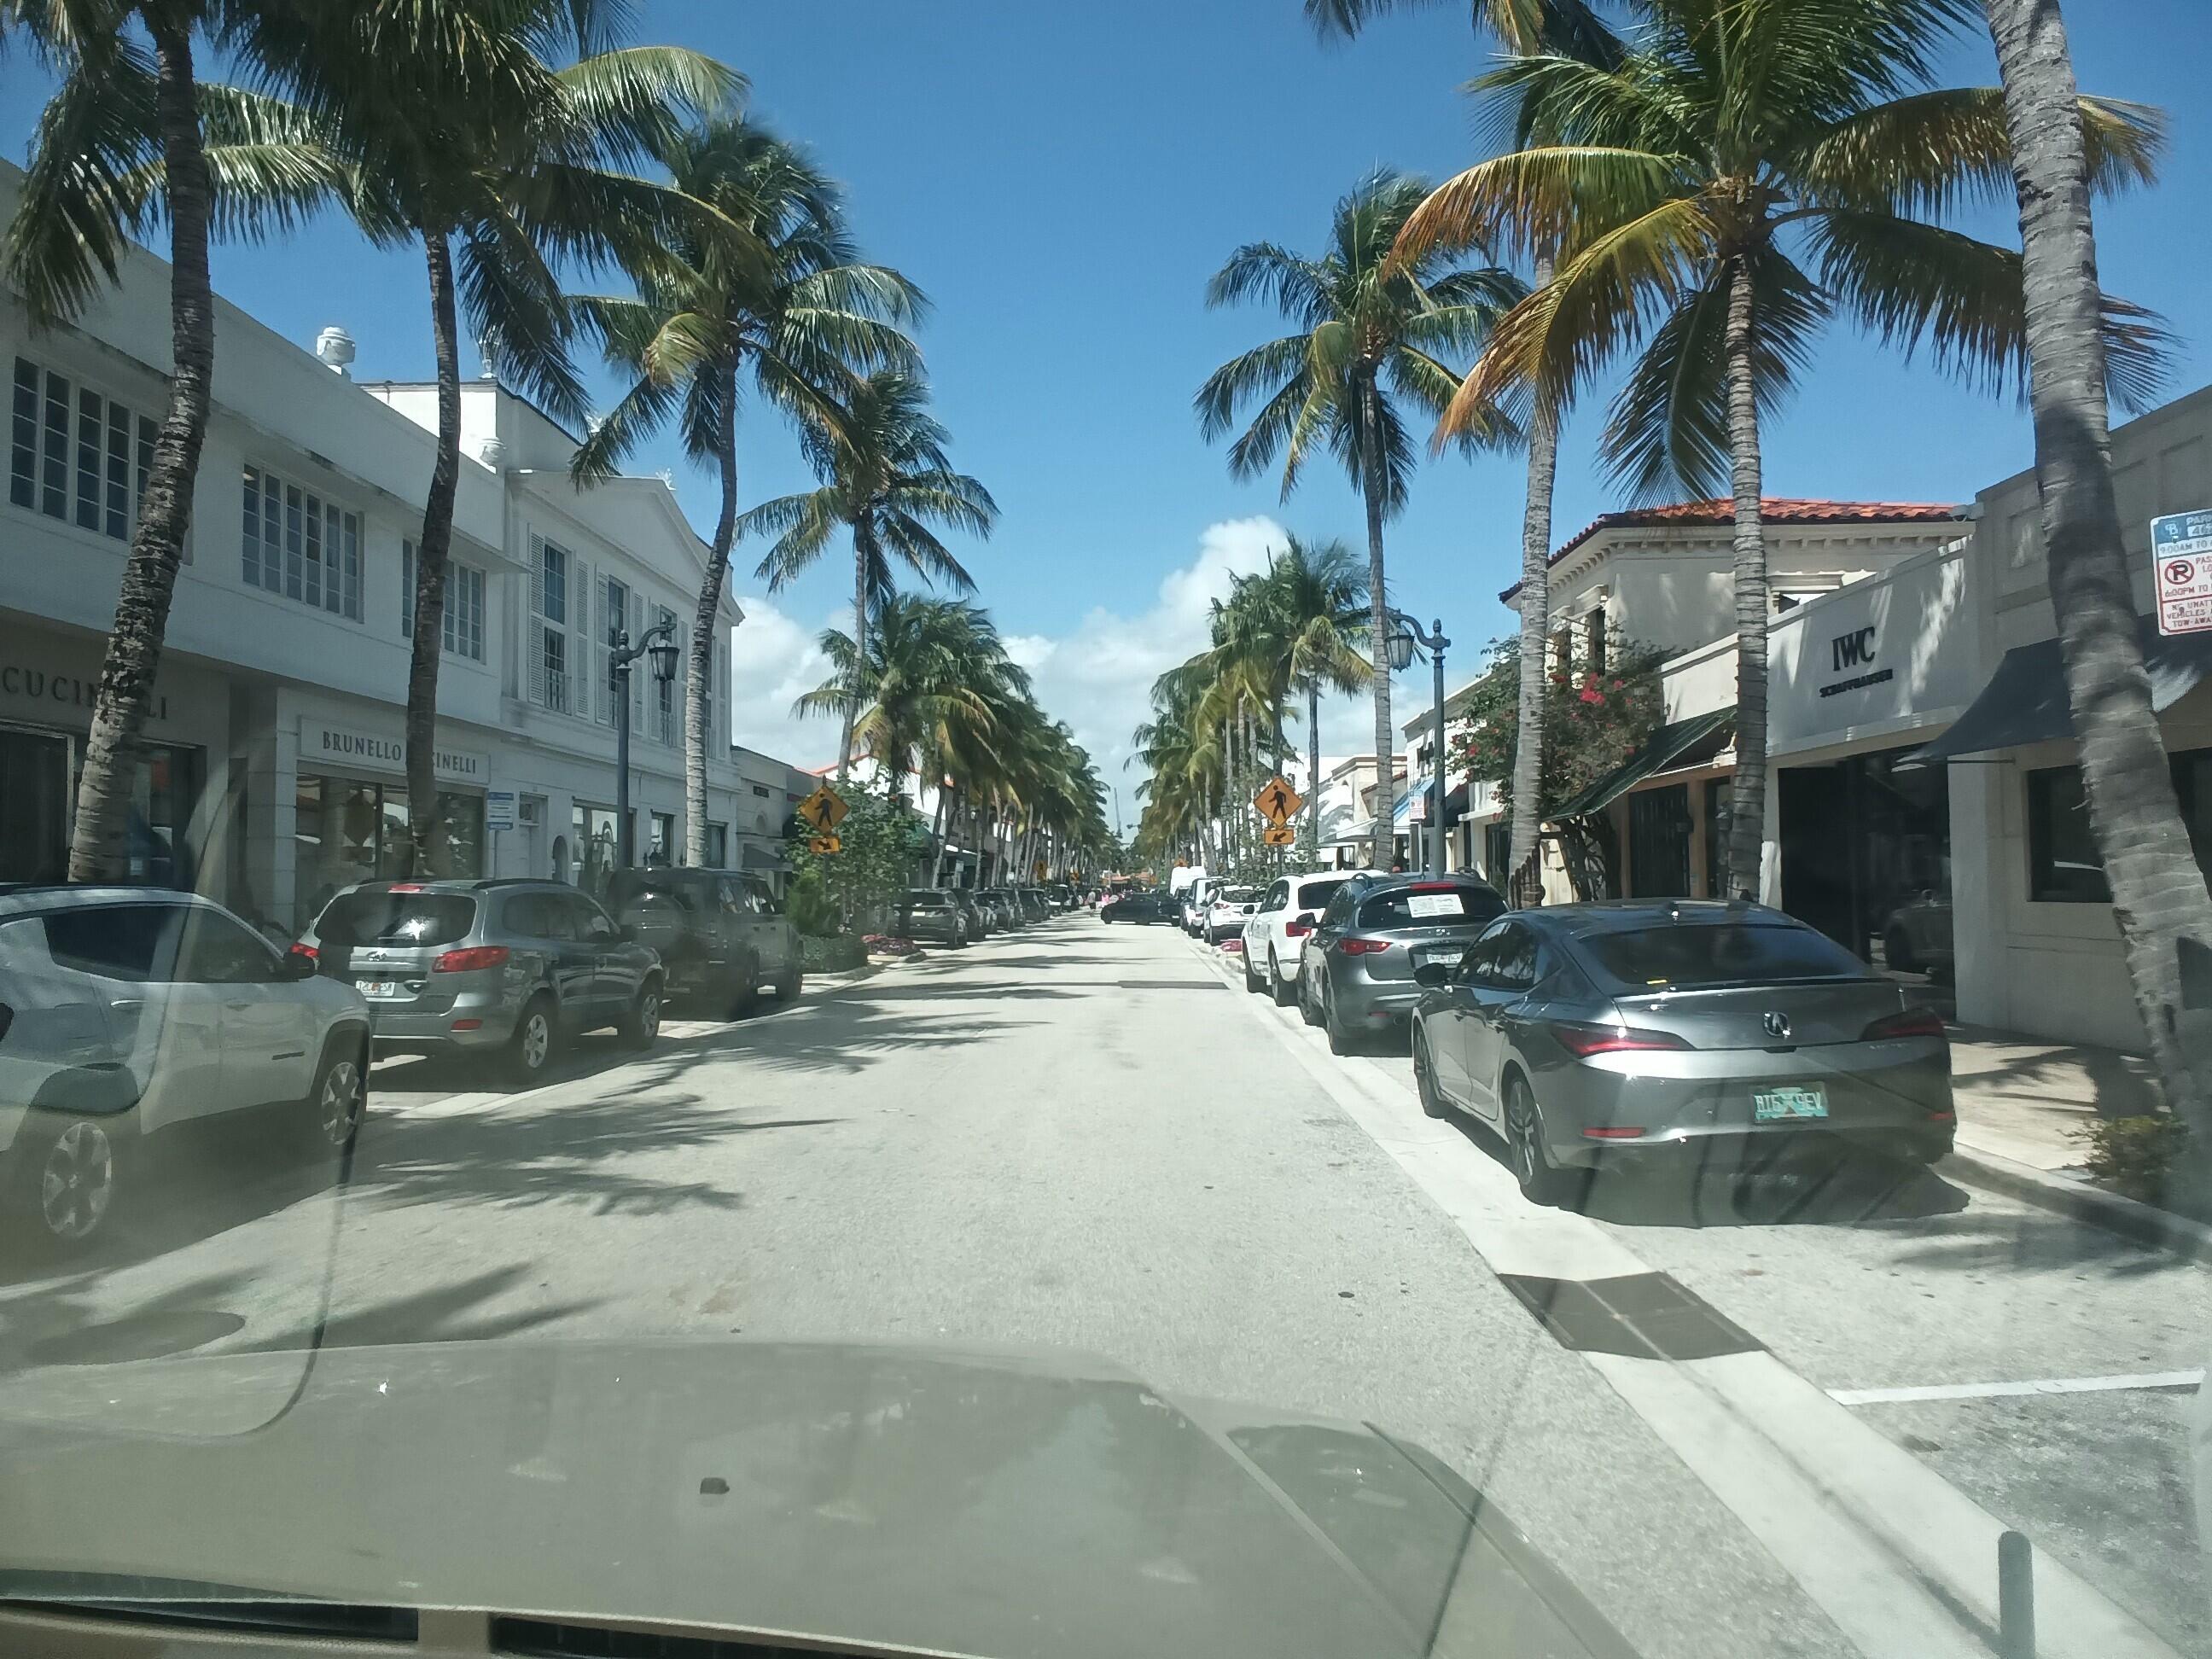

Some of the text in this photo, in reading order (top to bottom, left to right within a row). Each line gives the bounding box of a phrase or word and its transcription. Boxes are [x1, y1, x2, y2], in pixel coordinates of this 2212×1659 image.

[2197, 539, 2208, 549] TO
[2198, 584, 2208, 592] TO
[1831, 626, 1876, 672] IWC
[323, 731, 402, 761] BRUNELLO
